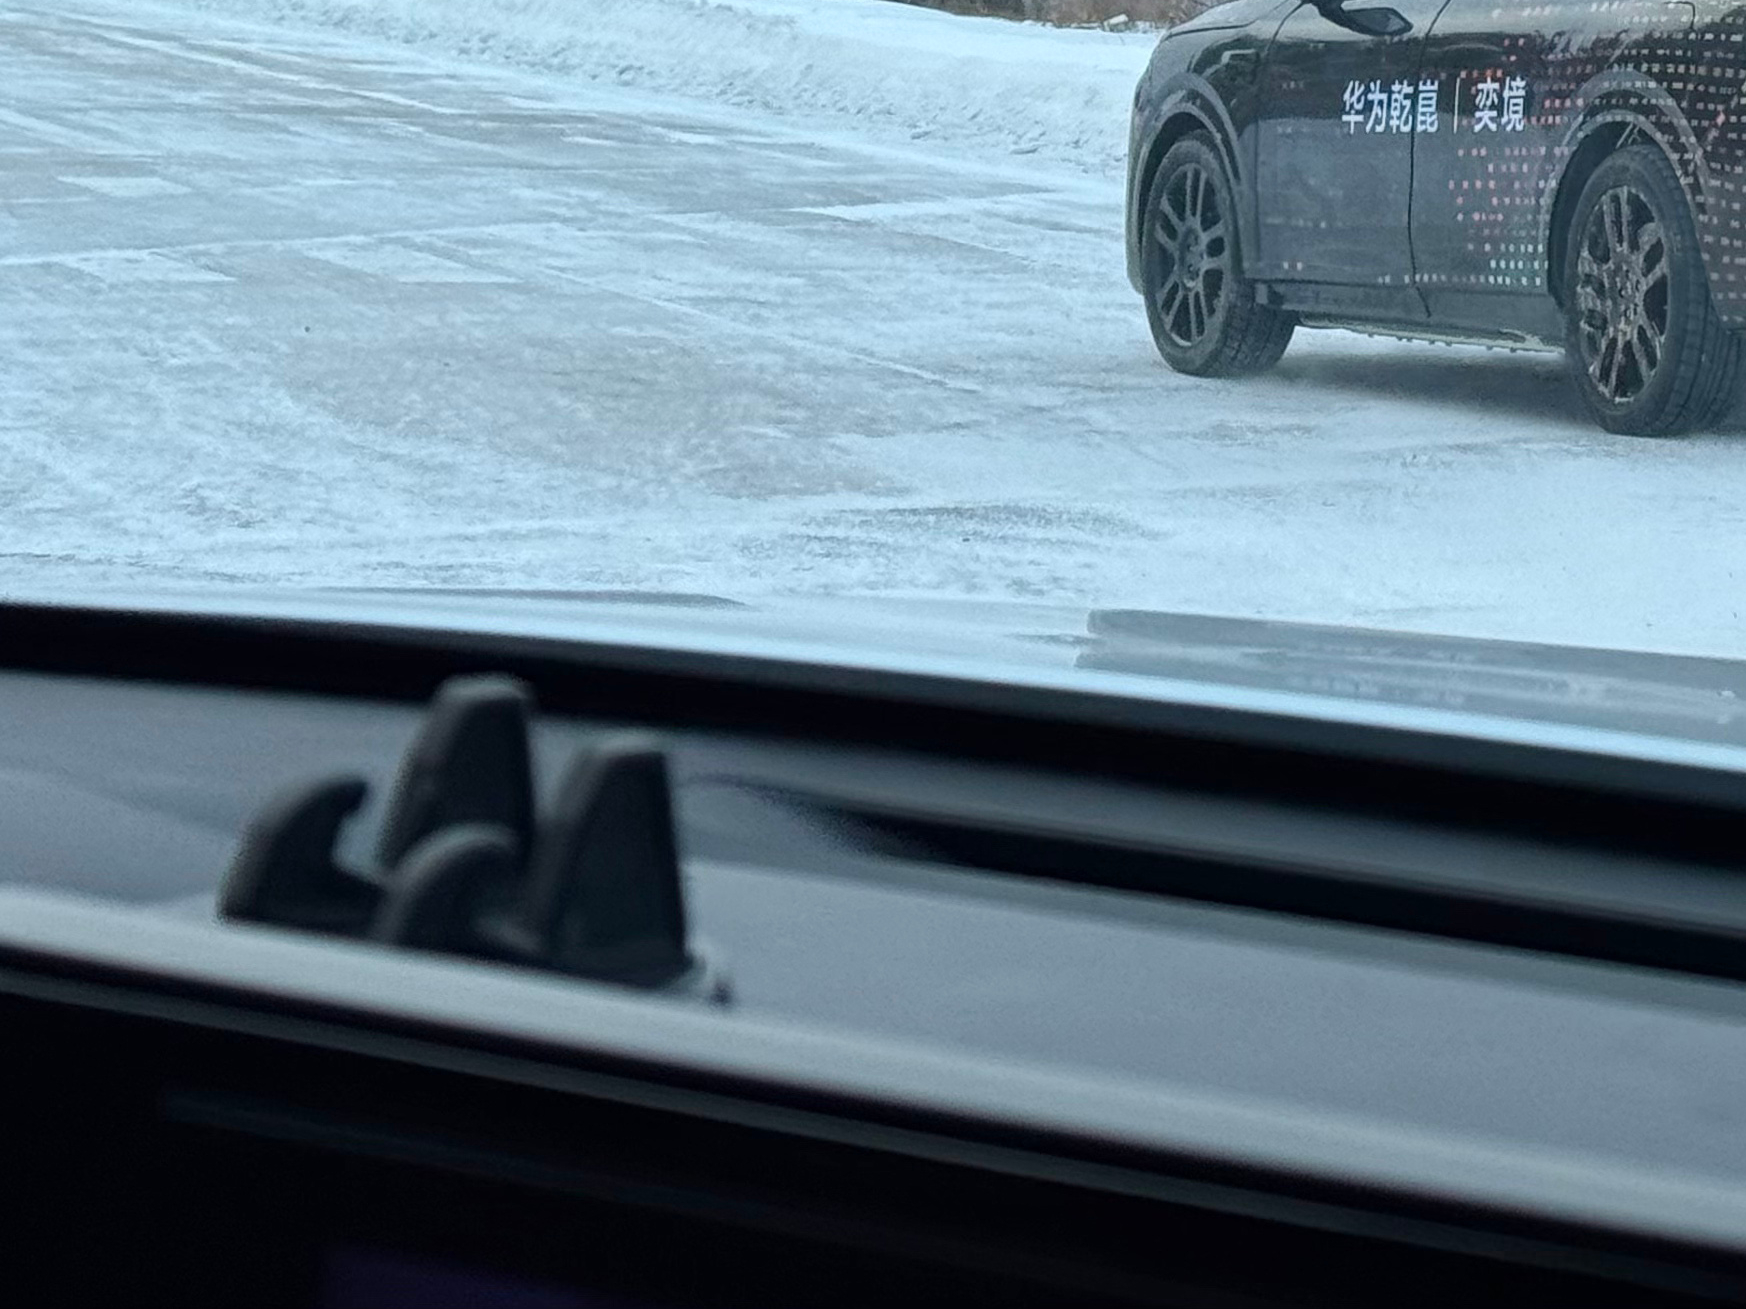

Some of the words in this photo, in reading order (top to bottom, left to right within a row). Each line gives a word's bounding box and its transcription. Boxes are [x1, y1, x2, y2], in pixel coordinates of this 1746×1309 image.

[1341, 79, 1439, 134] 华为乾崑
[1472, 76, 1527, 133] 奕境
